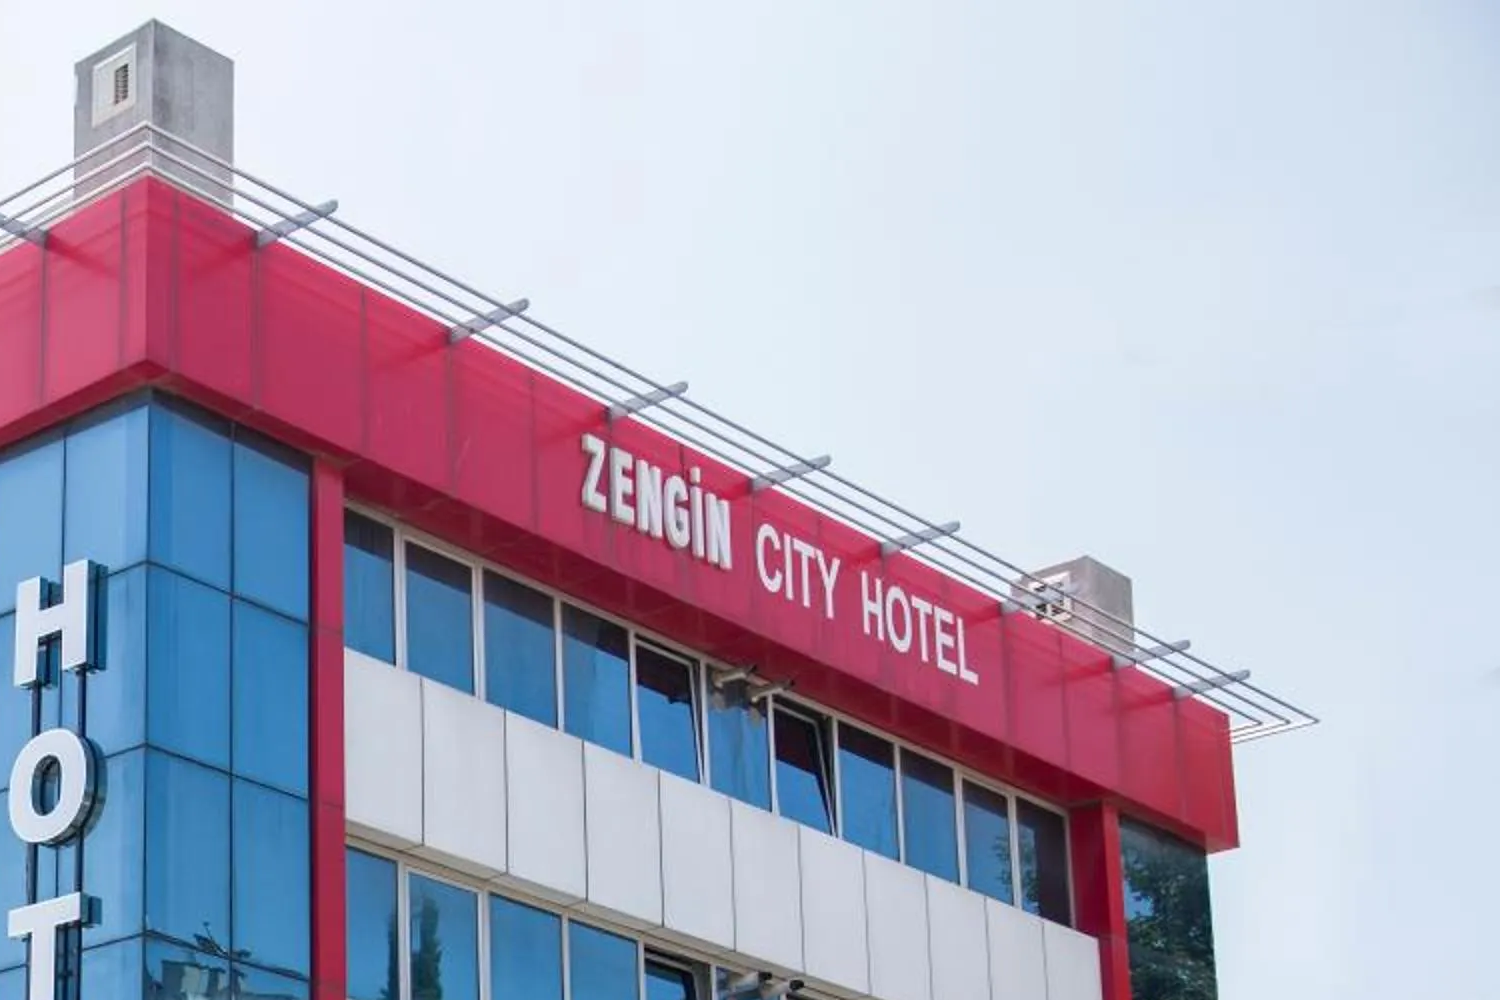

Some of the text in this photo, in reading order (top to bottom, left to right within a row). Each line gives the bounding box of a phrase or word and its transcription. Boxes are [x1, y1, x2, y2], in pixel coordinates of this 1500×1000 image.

[581, 433, 980, 685] ZENGİN CITY HOTEL
